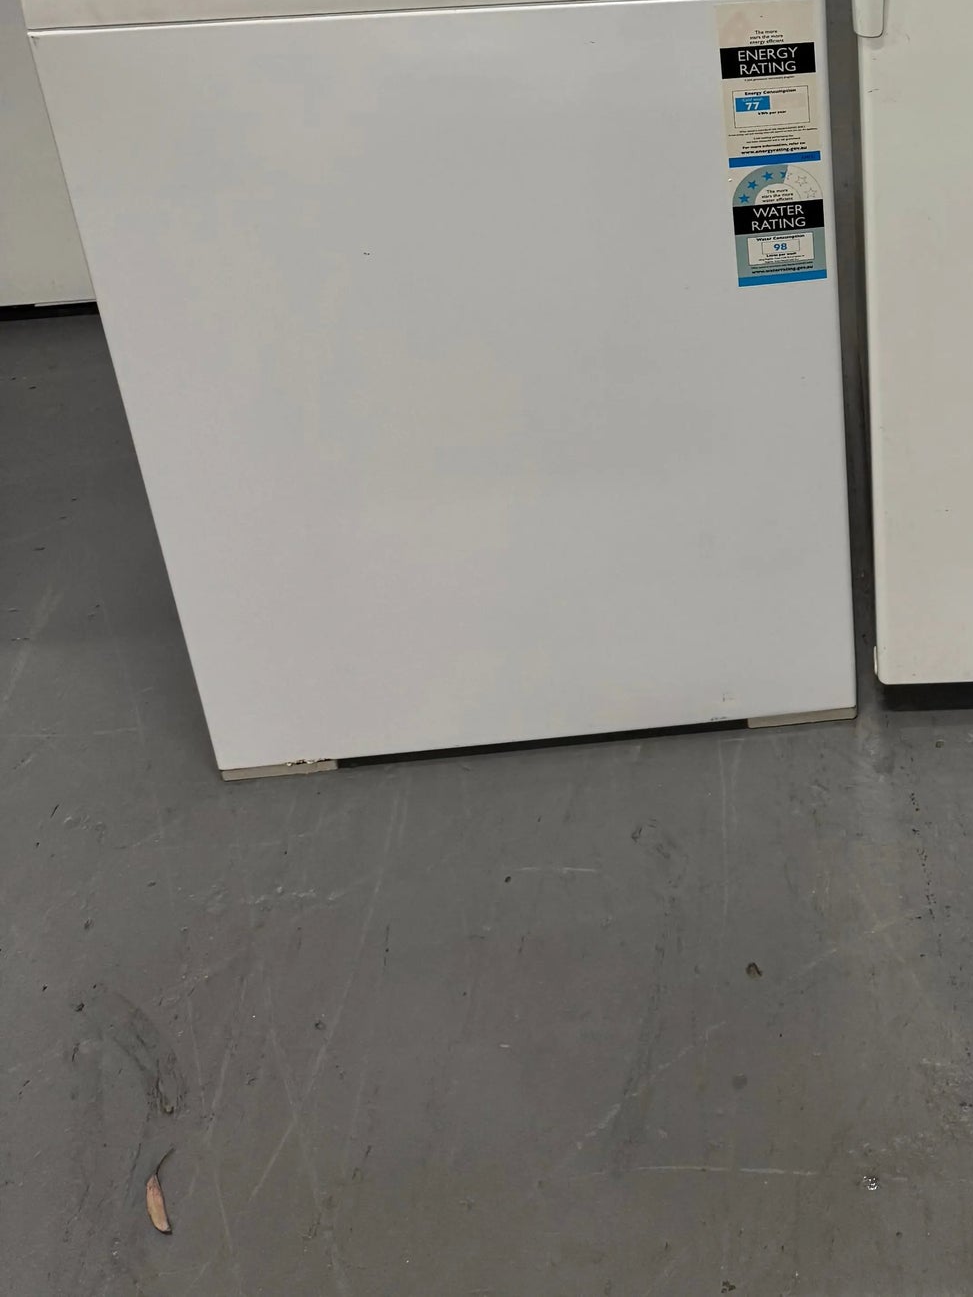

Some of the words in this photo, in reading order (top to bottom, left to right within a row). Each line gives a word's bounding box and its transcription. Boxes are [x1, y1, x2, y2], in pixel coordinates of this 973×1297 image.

[738, 46, 798, 62] ENERGY
[740, 61, 797, 76] RATING
[745, 101, 760, 111] 77
[752, 204, 804, 219] WATER
[751, 216, 806, 231] RATING
[773, 242, 788, 251] 98
